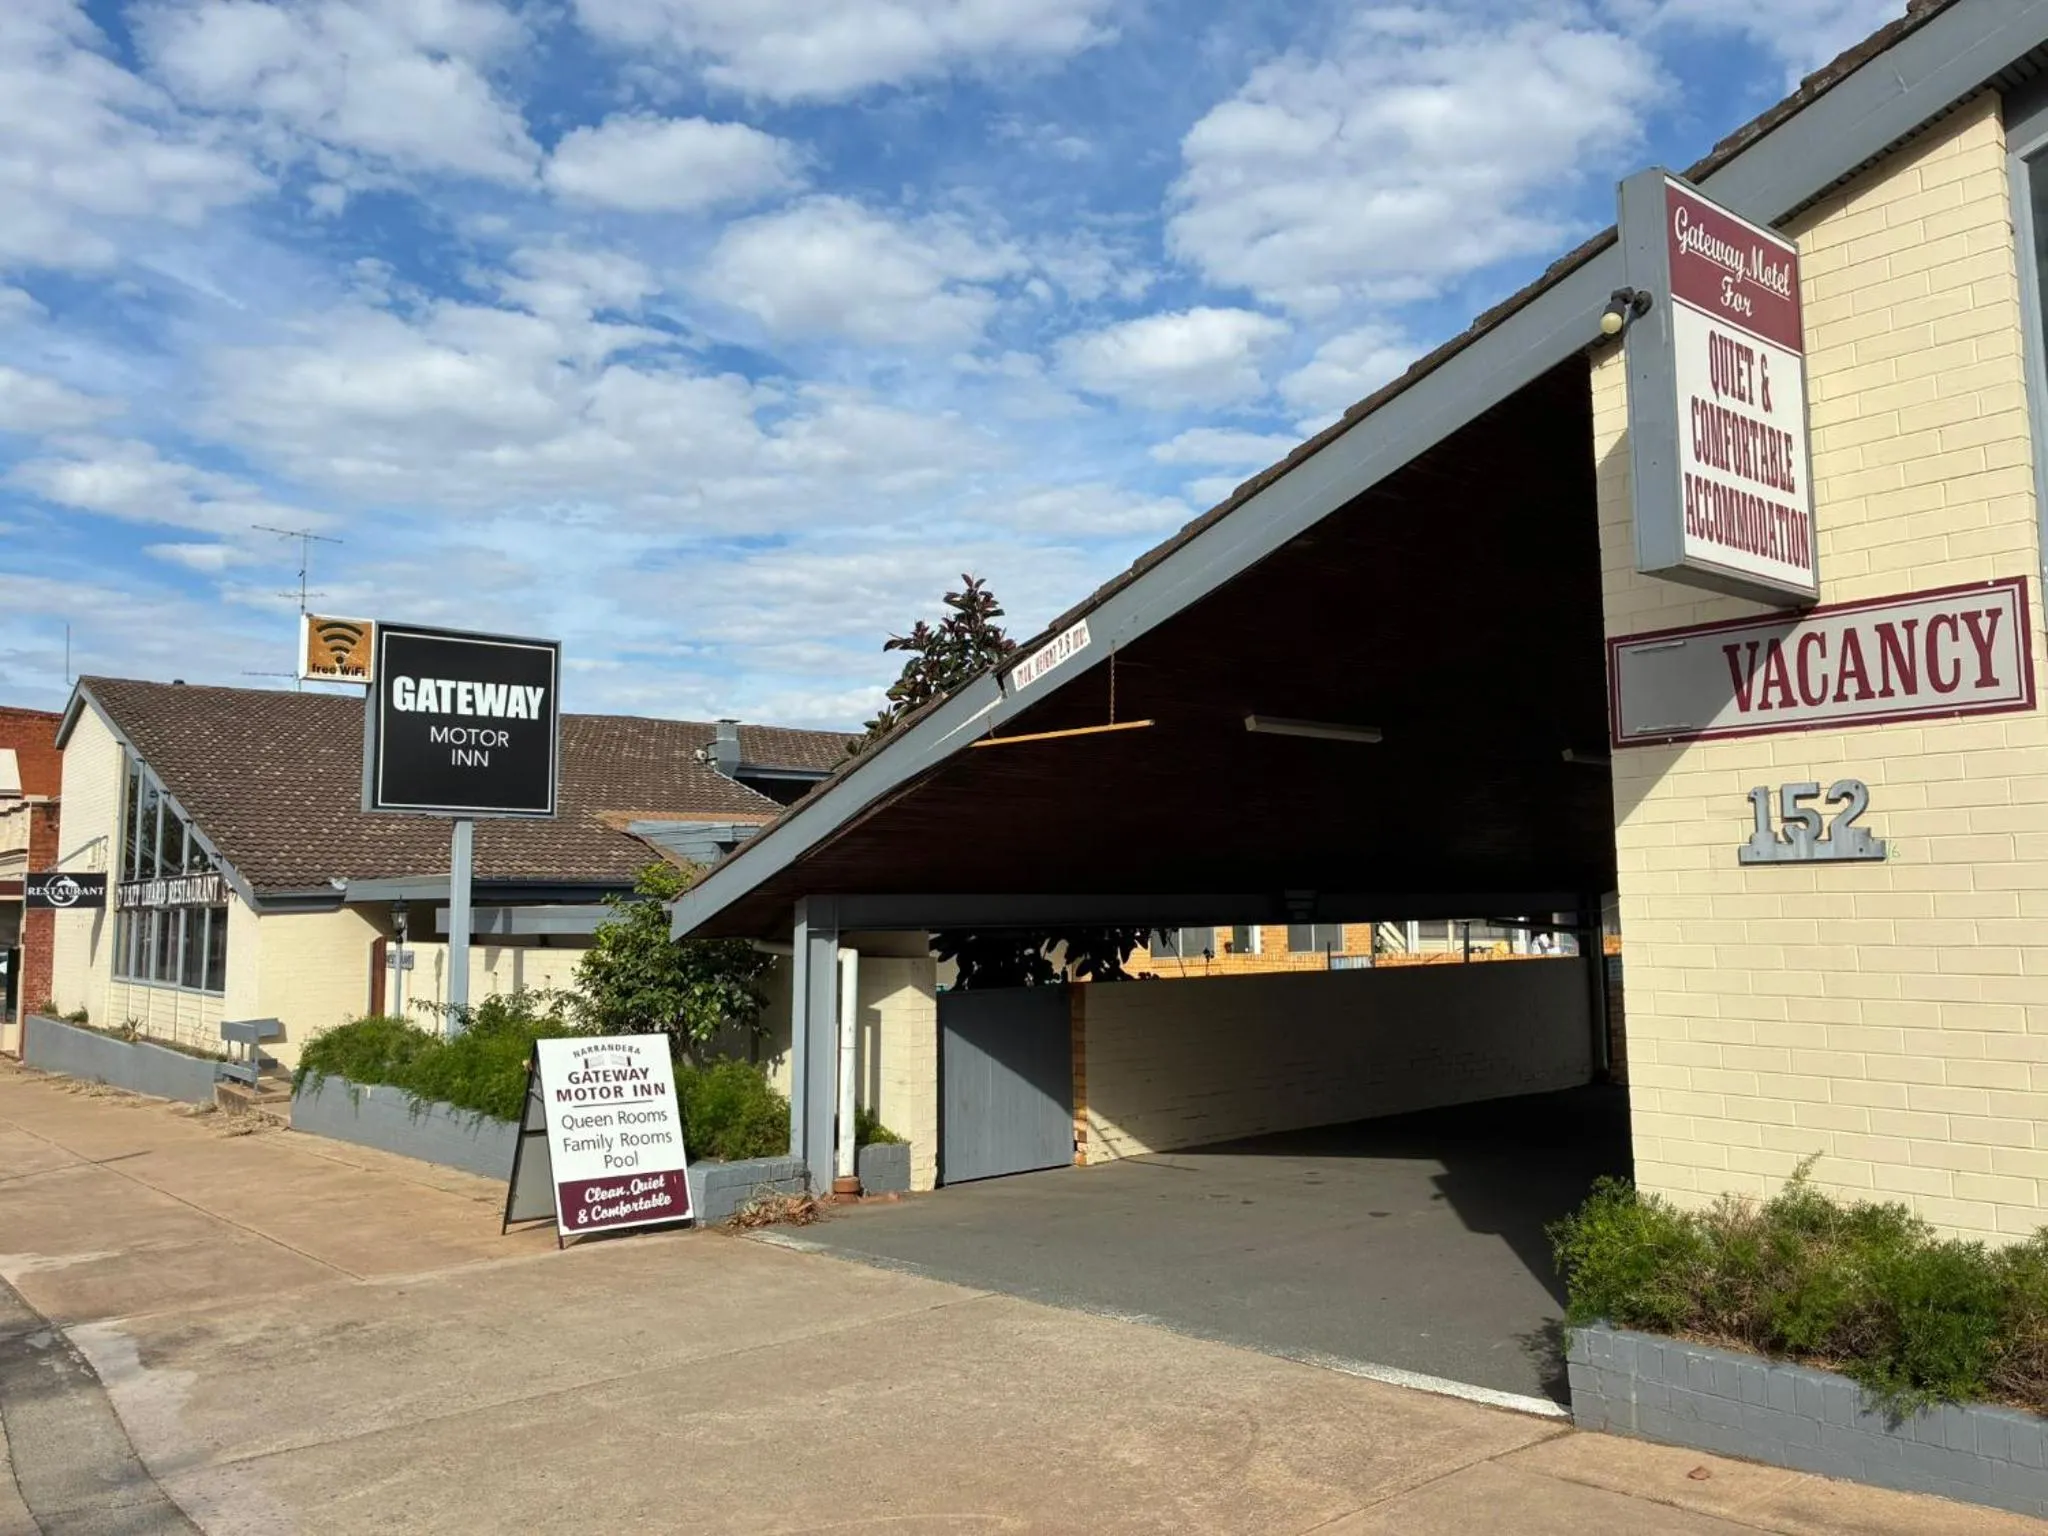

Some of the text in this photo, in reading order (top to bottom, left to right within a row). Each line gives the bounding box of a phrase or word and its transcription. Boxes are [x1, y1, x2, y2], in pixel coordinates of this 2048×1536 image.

[1674, 206, 1791, 296] Gateway Motel
[1720, 275, 1752, 317] For
[1708, 330, 1772, 413] QUIET &
[1691, 395, 1795, 494] COMFORTABLE
[1684, 472, 1810, 570] ACCOMMODATION
[311, 663, 366, 678] free WiFi
[1722, 607, 2003, 713] VACANCY
[393, 675, 545, 720] GATEWAY
[430, 726, 509, 748] MOTOR
[451, 749, 489, 767] INN
[1745, 779, 1876, 858] 152
[27, 885, 105, 898] RESTAURANT
[168, 876, 219, 904] RESTAURANT
[573, 1043, 641, 1059] NARRANDERA
[568, 1068, 650, 1085] GATEWAY
[556, 1082, 666, 1102] MOTOR INN
[561, 1109, 668, 1131] Queen Rooms
[563, 1131, 673, 1153] Family Rooms
[604, 1151, 639, 1168] Pool
[630, 1174, 665, 1193] Quiet
[577, 1193, 672, 1224] & Comfortable
